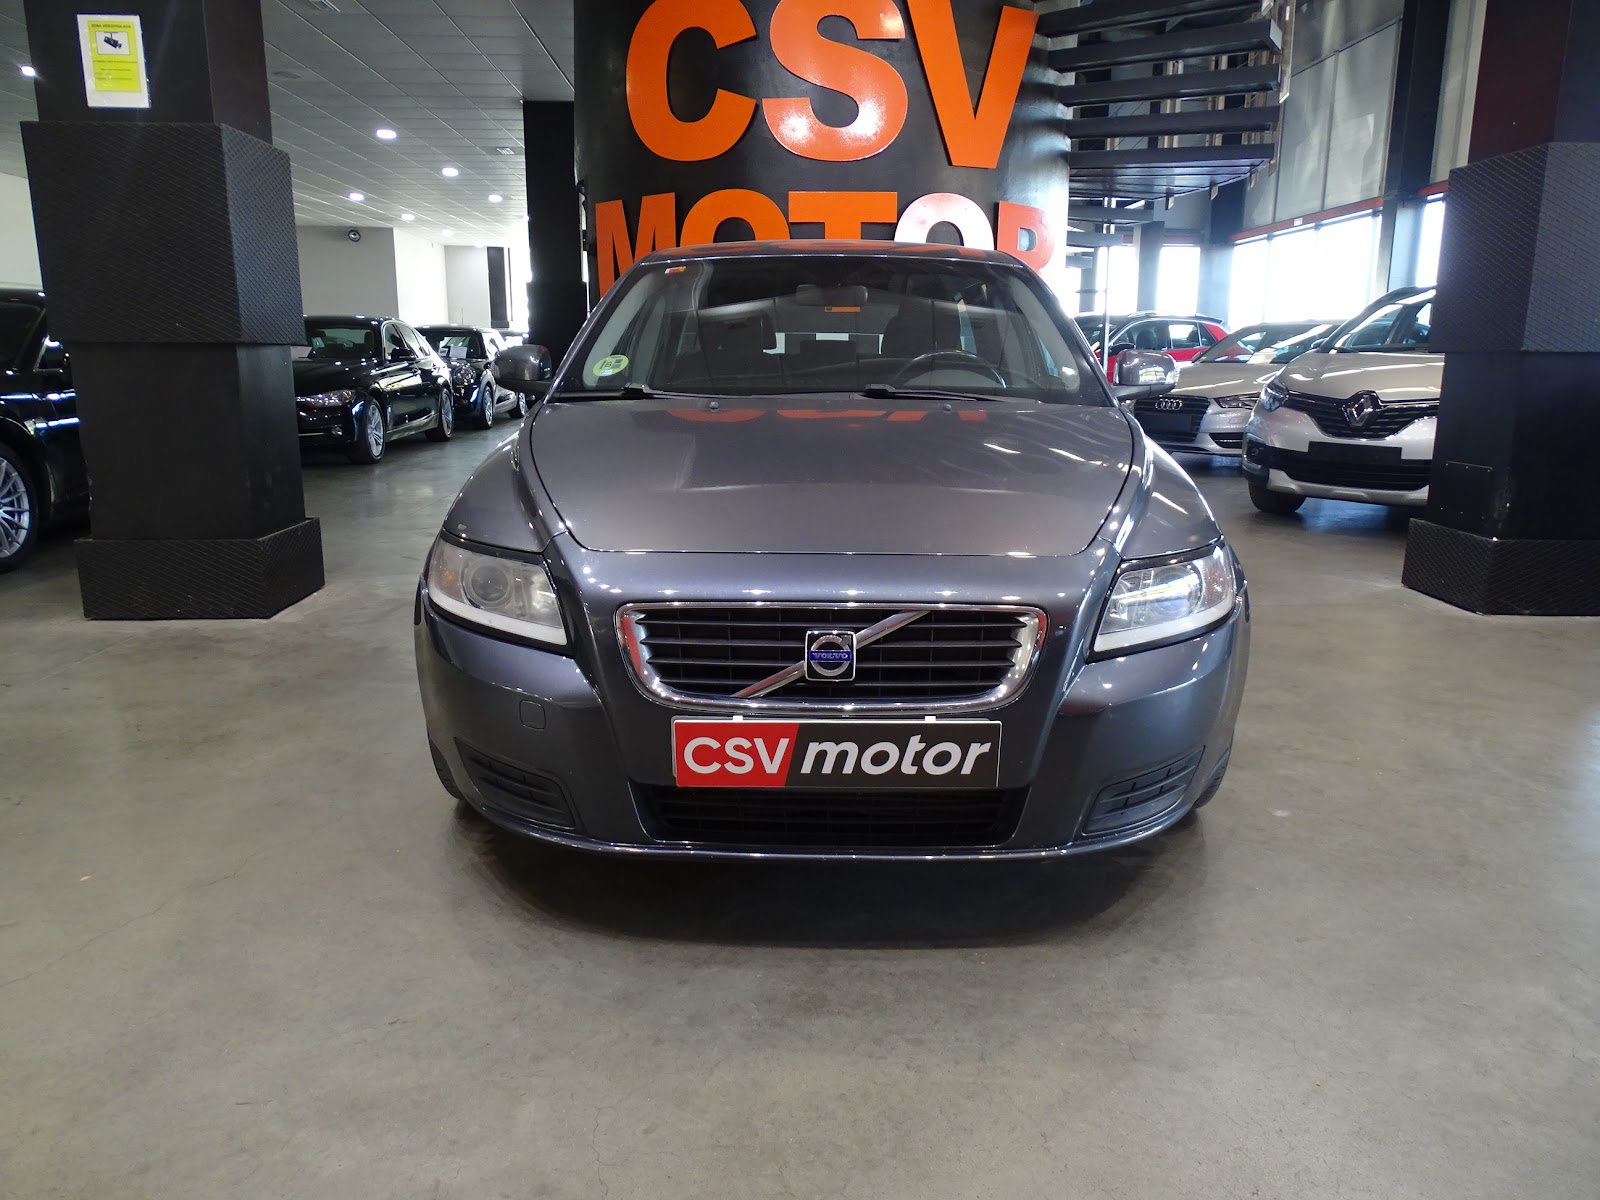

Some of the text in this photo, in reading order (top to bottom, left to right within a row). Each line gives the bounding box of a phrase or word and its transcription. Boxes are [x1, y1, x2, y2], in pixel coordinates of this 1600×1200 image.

[626, 0, 1039, 168] CSV
[683, 734, 992, 775] CSV motor
